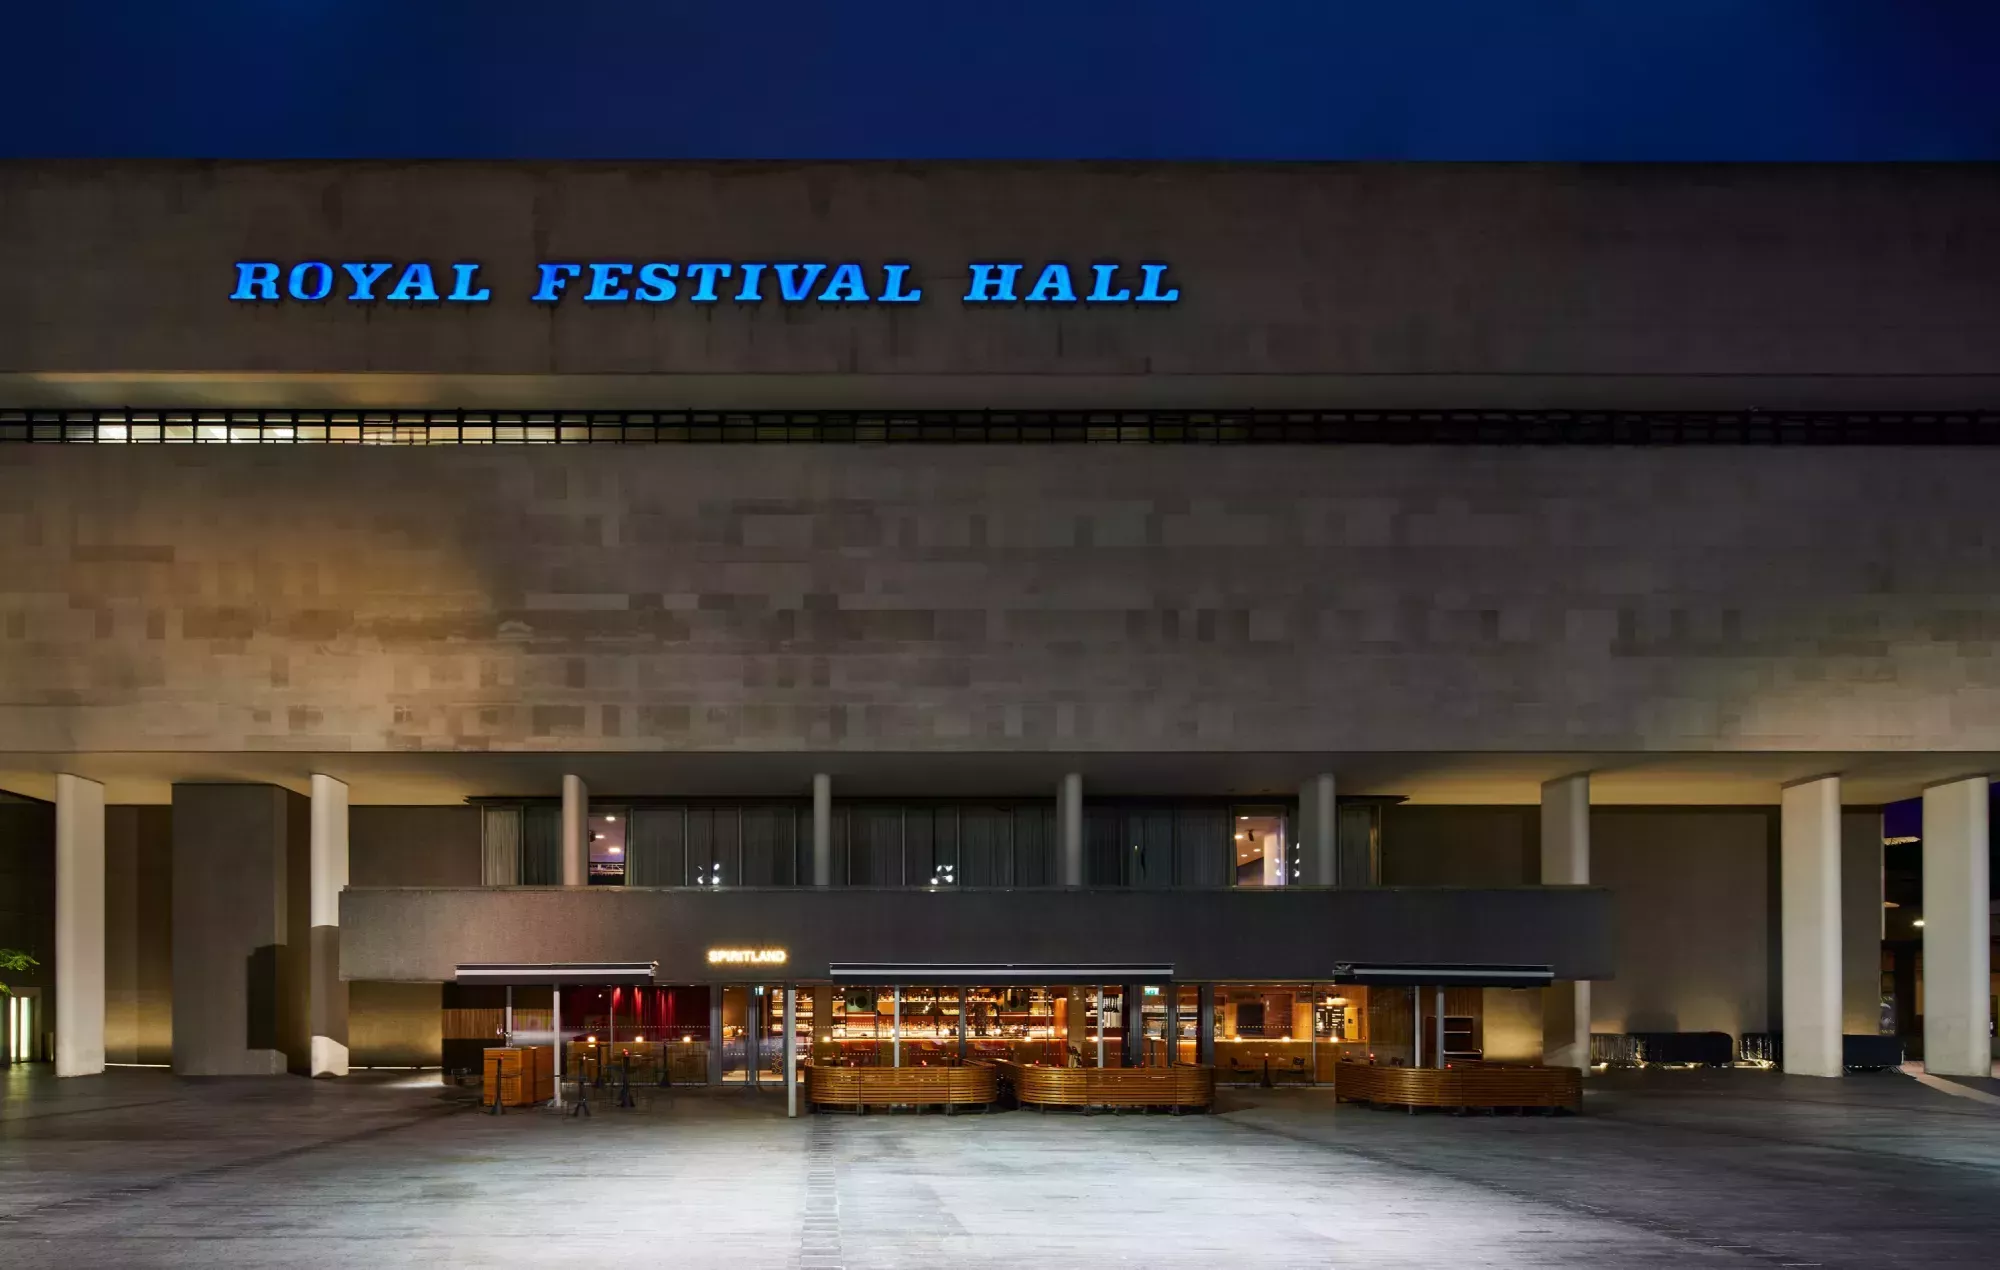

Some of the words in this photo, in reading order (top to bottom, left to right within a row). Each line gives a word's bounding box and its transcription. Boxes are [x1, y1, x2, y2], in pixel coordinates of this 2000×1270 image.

[229, 261, 490, 302] ROYAL
[531, 261, 922, 303] FESTIVAL
[963, 262, 1179, 303] HALL
[707, 949, 787, 963] SPIRITLAND
